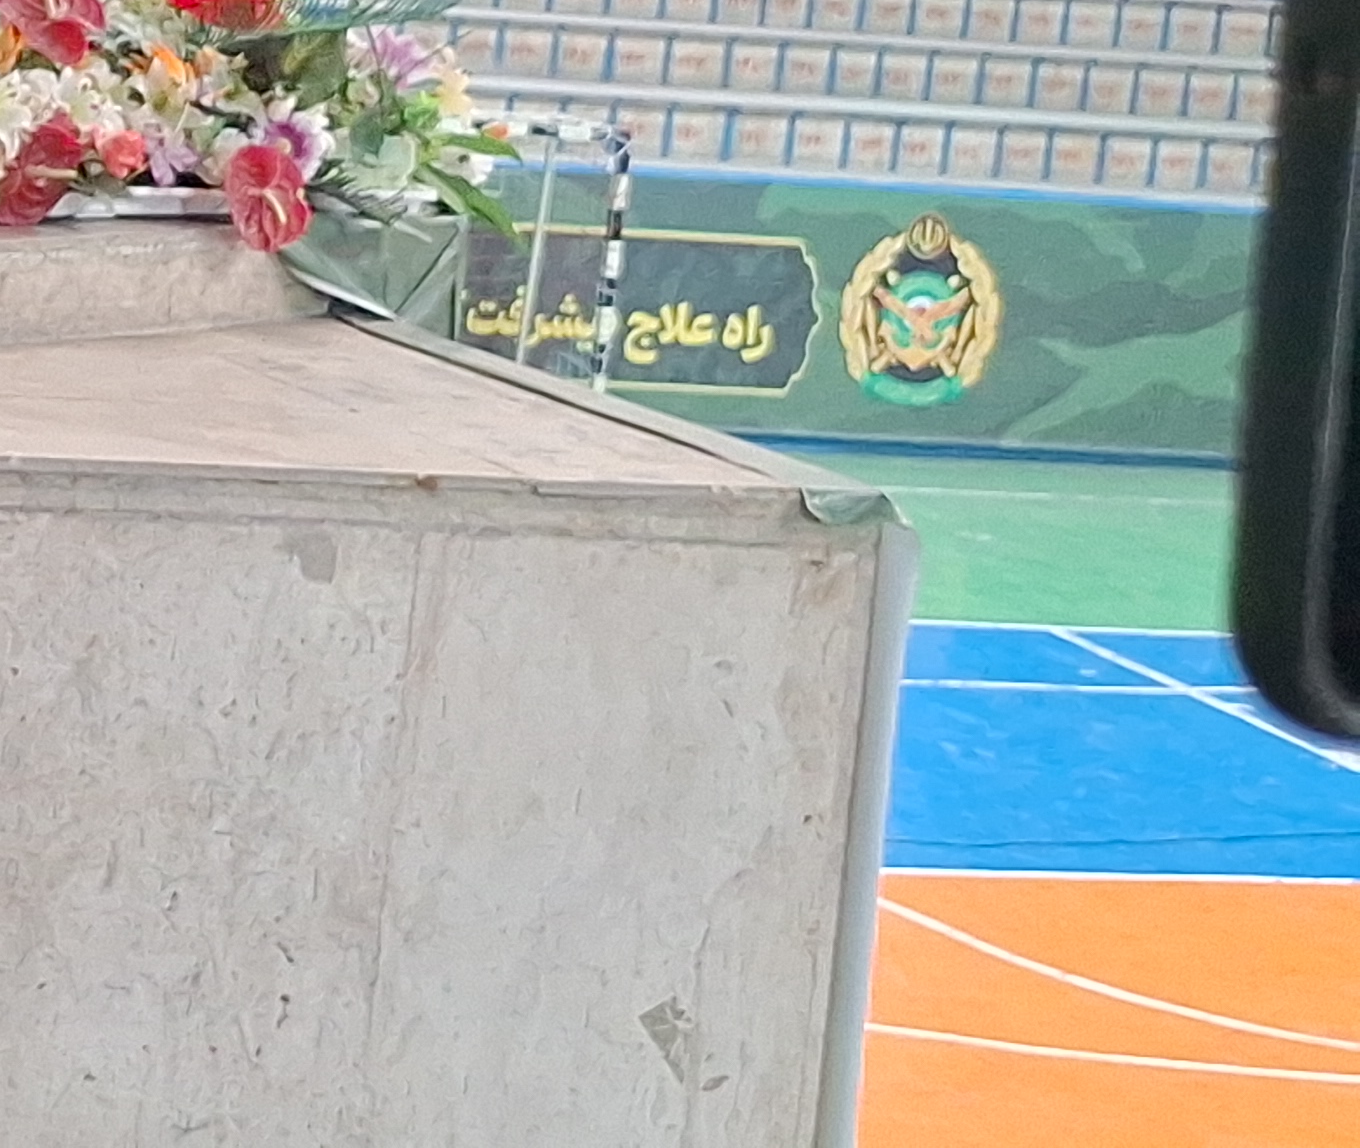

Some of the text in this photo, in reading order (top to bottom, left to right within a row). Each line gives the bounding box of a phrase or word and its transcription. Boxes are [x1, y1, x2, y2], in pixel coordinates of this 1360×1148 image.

[466, 284, 776, 365] راه علاج یشرفت
